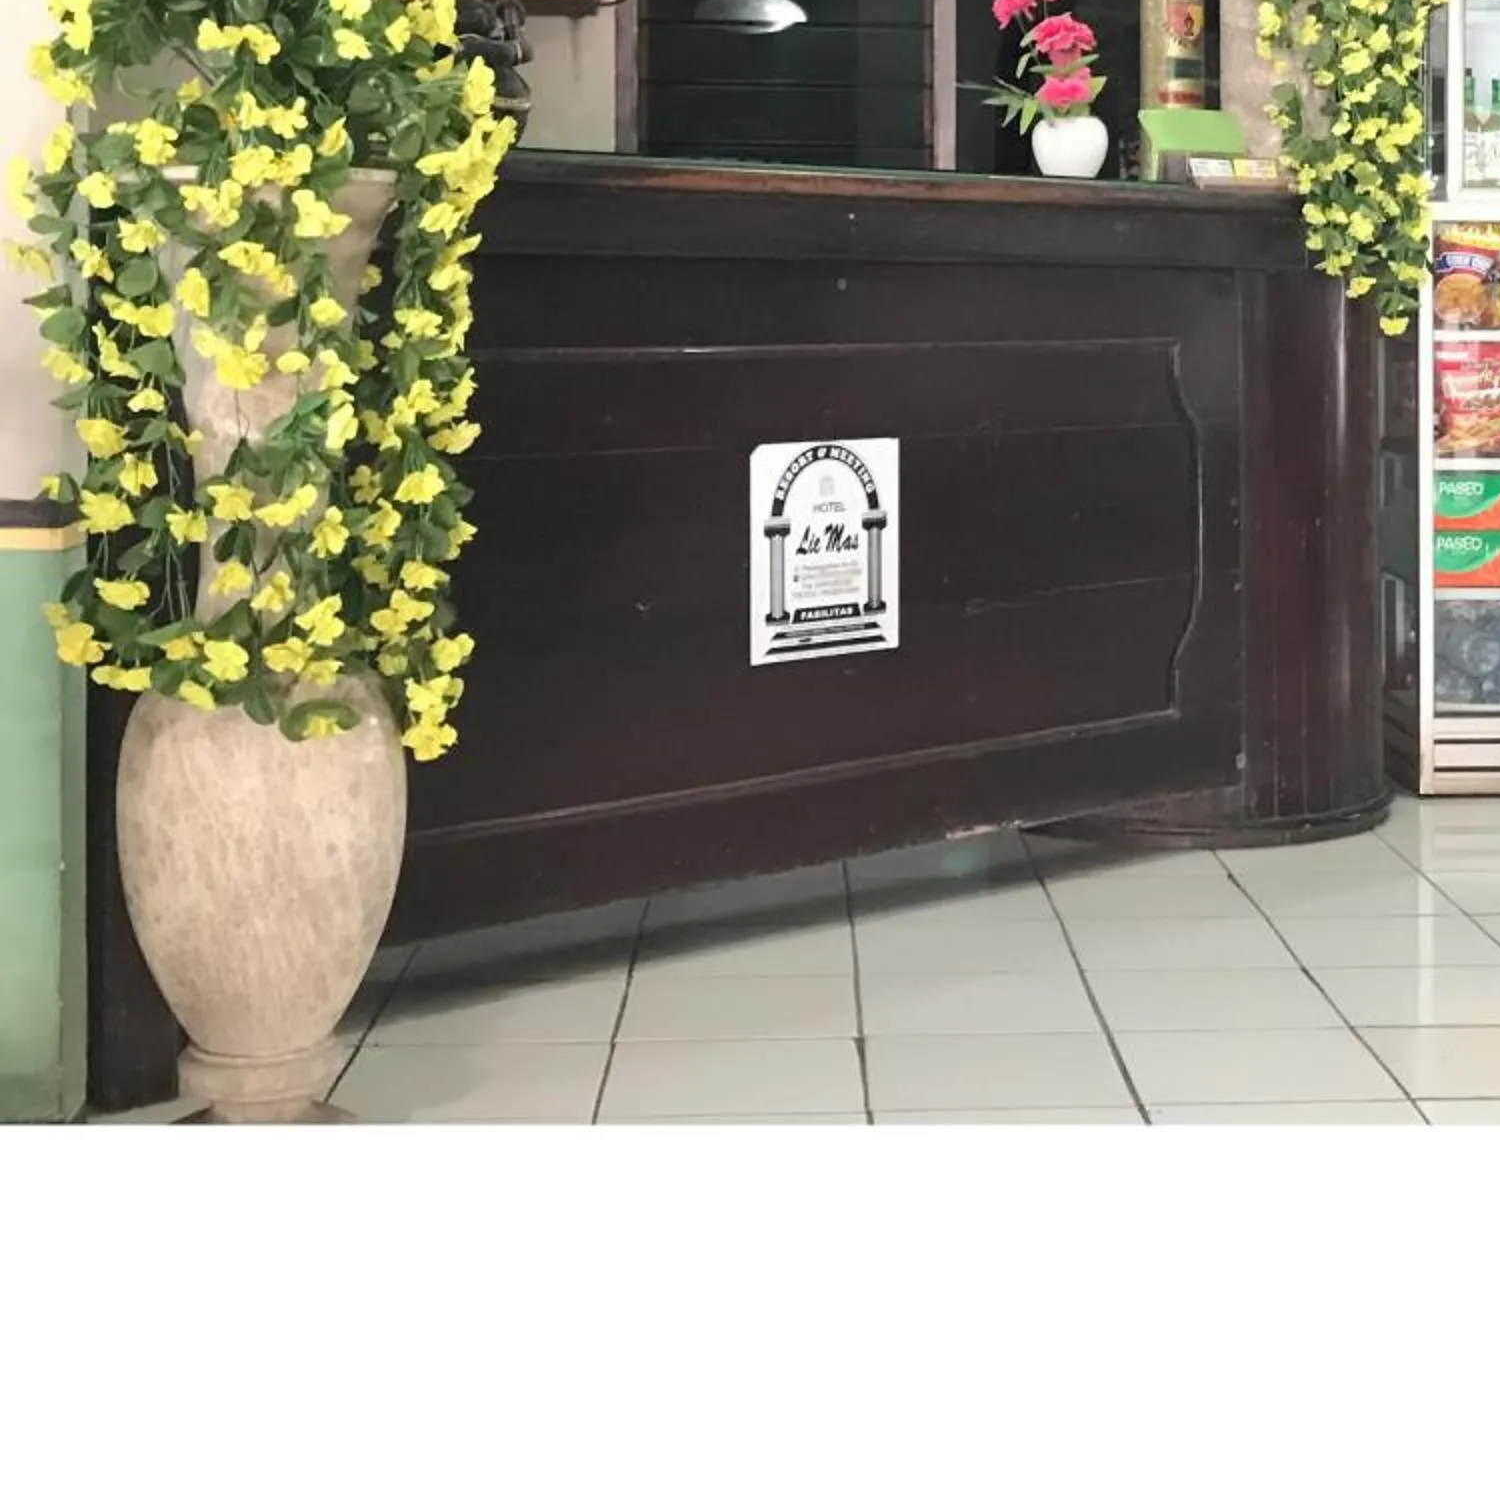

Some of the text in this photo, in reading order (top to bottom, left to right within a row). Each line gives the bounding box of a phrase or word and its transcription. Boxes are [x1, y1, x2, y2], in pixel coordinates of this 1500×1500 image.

[1439, 481, 1485, 496] PASEO
[813, 501, 848, 513] HOTEL
[1436, 536, 1483, 551] PASEO
